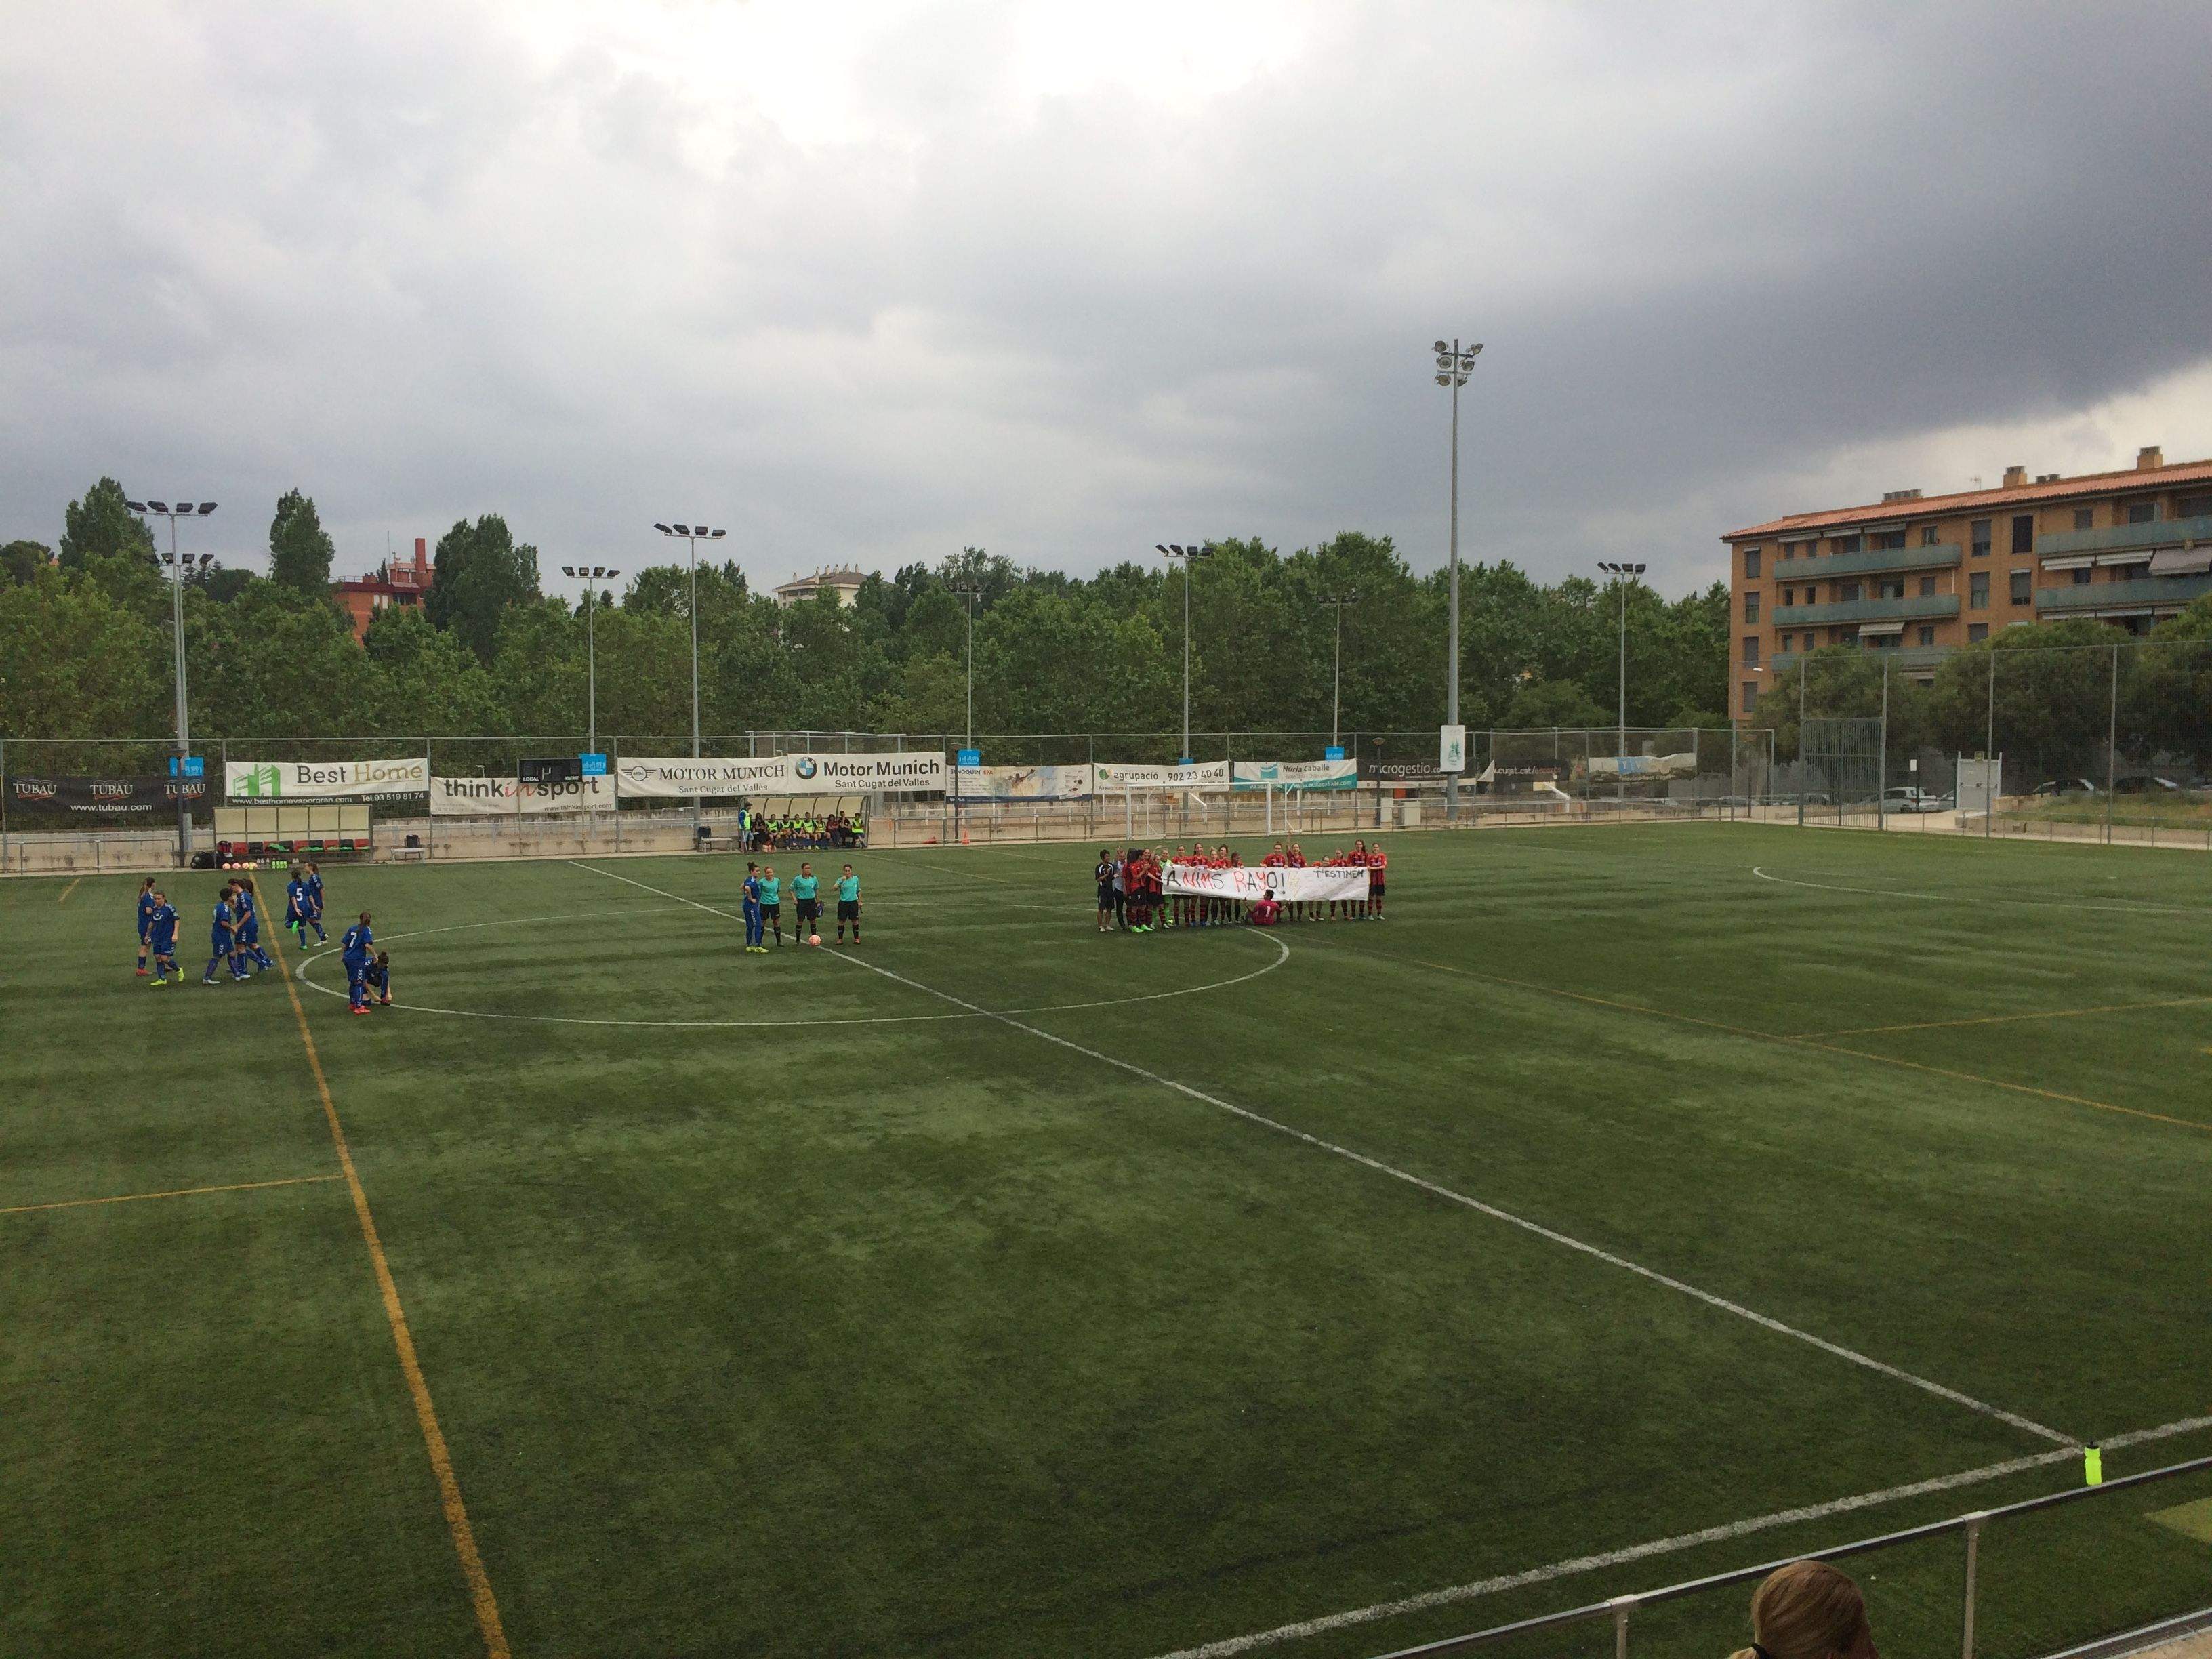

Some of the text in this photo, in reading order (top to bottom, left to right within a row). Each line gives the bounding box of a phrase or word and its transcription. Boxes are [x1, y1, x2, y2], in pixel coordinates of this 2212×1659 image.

[297, 763, 423, 783] Best Home
[659, 765, 785, 780] MOTOR MUNICH
[823, 762, 873, 777] Motor
[876, 758, 939, 775] Munich
[1114, 768, 1224, 781] agrupació 902 23 40 40
[13, 783, 57, 794] TUBAU
[90, 784, 133, 794] TUBAU
[700, 785, 724, 794] Cugat
[835, 778, 930, 790] Sant Cugat del Vallès
[1233, 871, 1286, 895] RAYO!
[296, 888, 303, 901] 5
[349, 932, 357, 947] 7
